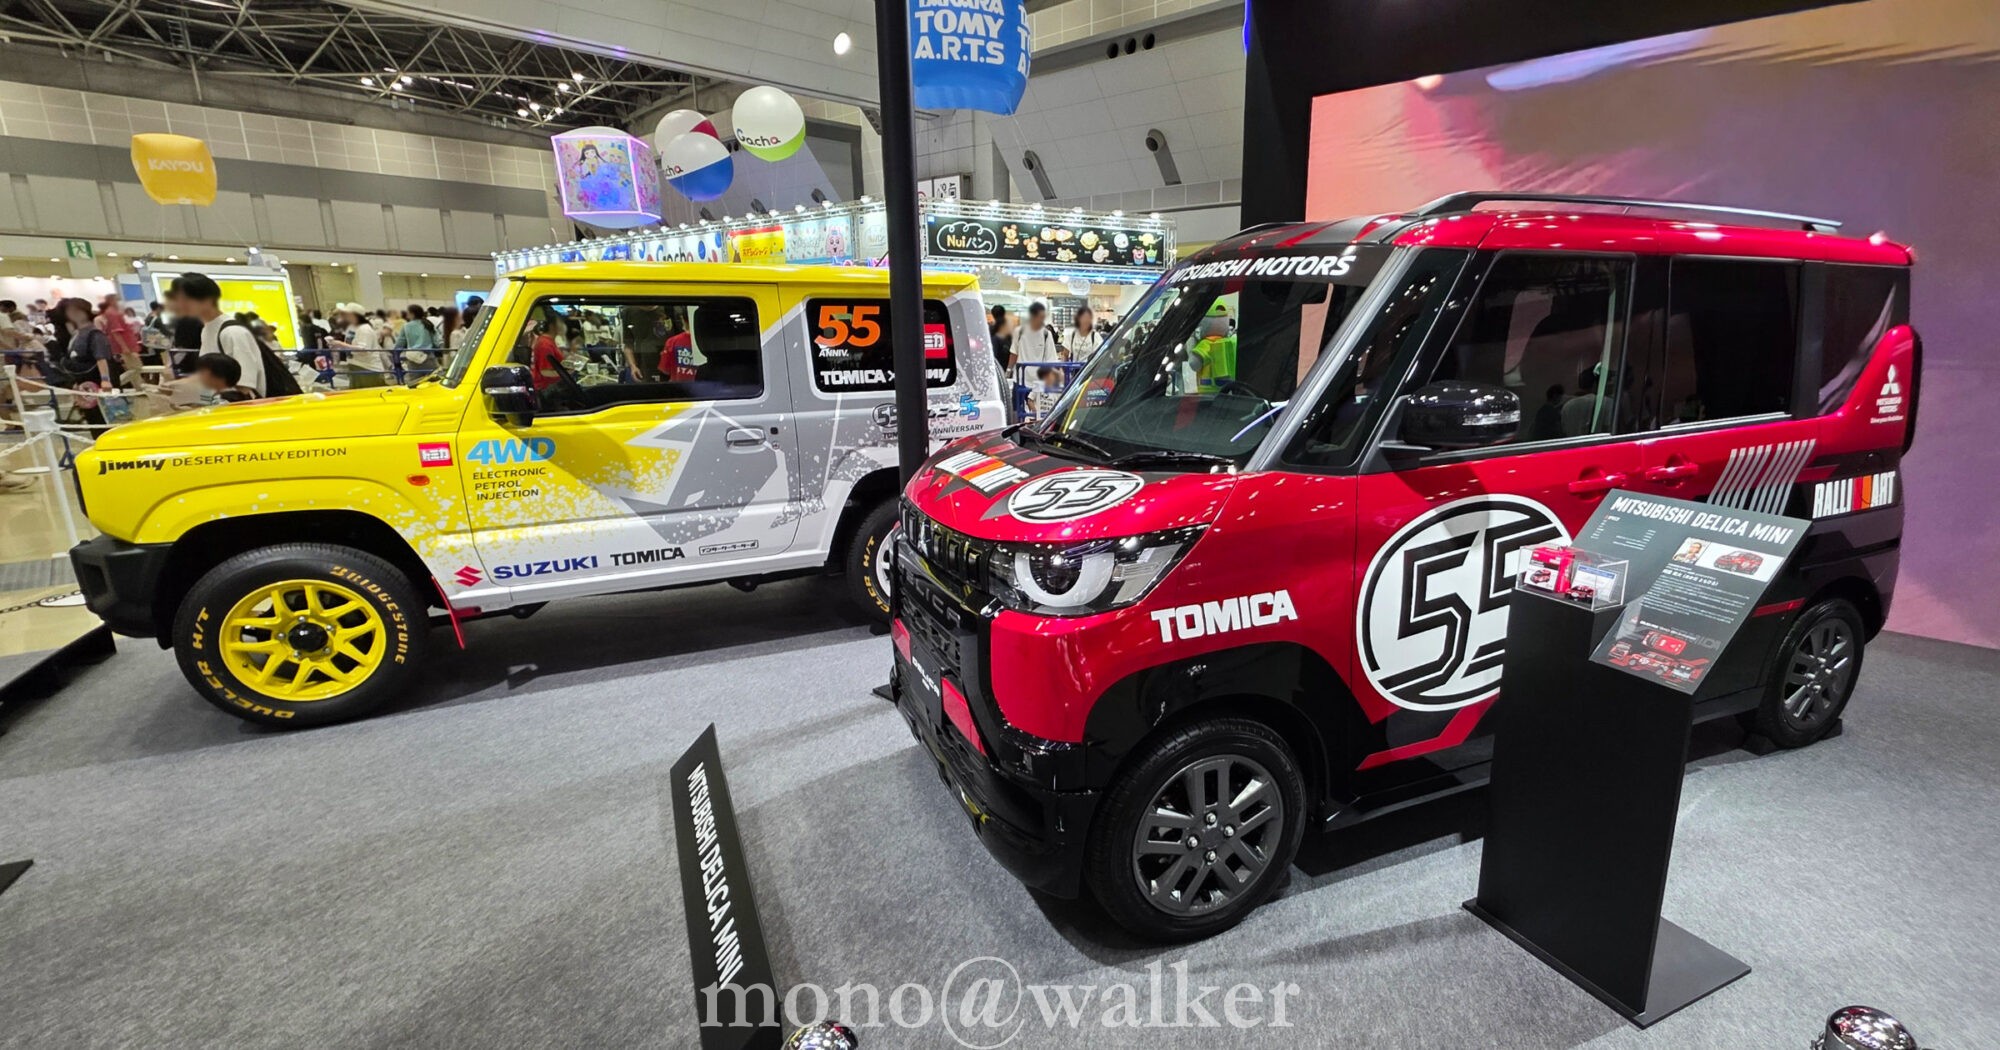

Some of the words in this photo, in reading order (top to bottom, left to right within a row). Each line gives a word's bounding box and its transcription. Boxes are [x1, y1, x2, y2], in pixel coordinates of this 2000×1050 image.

[914, 9, 1004, 39] TOMY
[914, 35, 1005, 65] A.R.T.S
[736, 128, 781, 147] Gacha
[663, 165, 684, 177] cha
[1167, 258, 1252, 284] MITSUBISHI
[1247, 255, 1356, 276] MOTORS
[814, 305, 881, 347] 55
[924, 332, 945, 349] ミカ
[819, 348, 849, 358] ANNIV.
[820, 369, 887, 386] TOMICA
[98, 459, 166, 475] Jimny
[172, 454, 233, 467] DESERT
[237, 451, 289, 463] RALLY
[287, 447, 347, 460] EDITION
[466, 436, 557, 466] 4WD
[473, 467, 546, 480] ELECTRONIC
[475, 480, 522, 491] PETROL
[476, 488, 539, 501] INJECTION
[1012, 474, 1141, 519] 55
[1610, 496, 1695, 528] MITSUBISHI
[1690, 511, 1750, 537] DELICA
[1748, 522, 1794, 545] MINI
[493, 555, 598, 580] SUZUKI
[610, 547, 685, 567] TOMICA
[863, 575, 891, 613] ELER
[330, 564, 409, 665] BRIDGESTONE
[1150, 589, 1299, 643] TOMICA
[196, 660, 296, 720] DUELER
[687, 761, 718, 856] MITSUBISHI
[700, 843, 731, 932] DELICA
[713, 917, 744, 990] MINI
